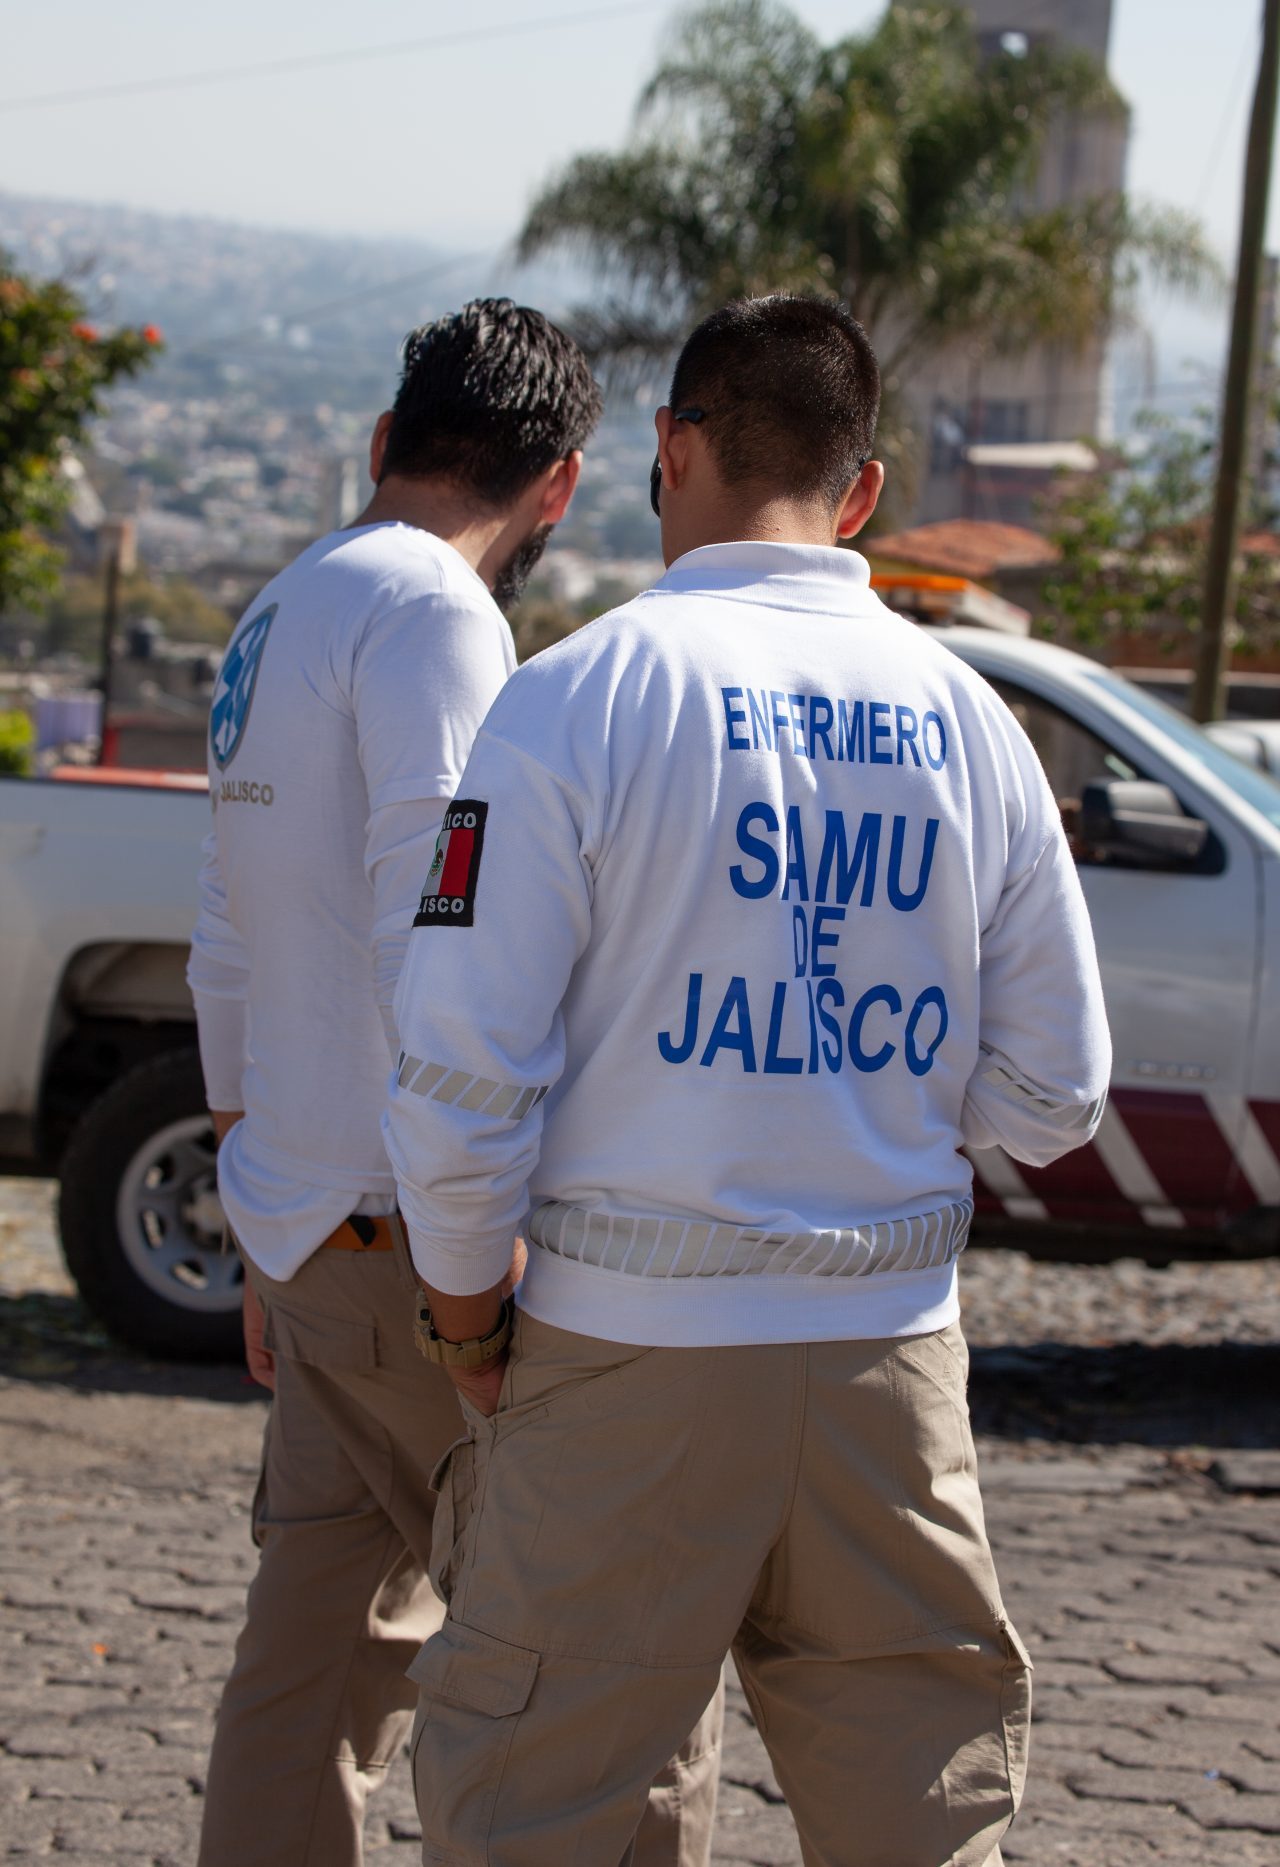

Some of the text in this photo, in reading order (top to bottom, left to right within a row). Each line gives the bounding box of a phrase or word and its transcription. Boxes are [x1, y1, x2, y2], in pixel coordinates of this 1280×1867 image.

[721, 687, 947, 771] ENFERMERO
[729, 801, 940, 912] SAMU
[792, 904, 846, 978] DE
[657, 972, 949, 1077] JALISCO
